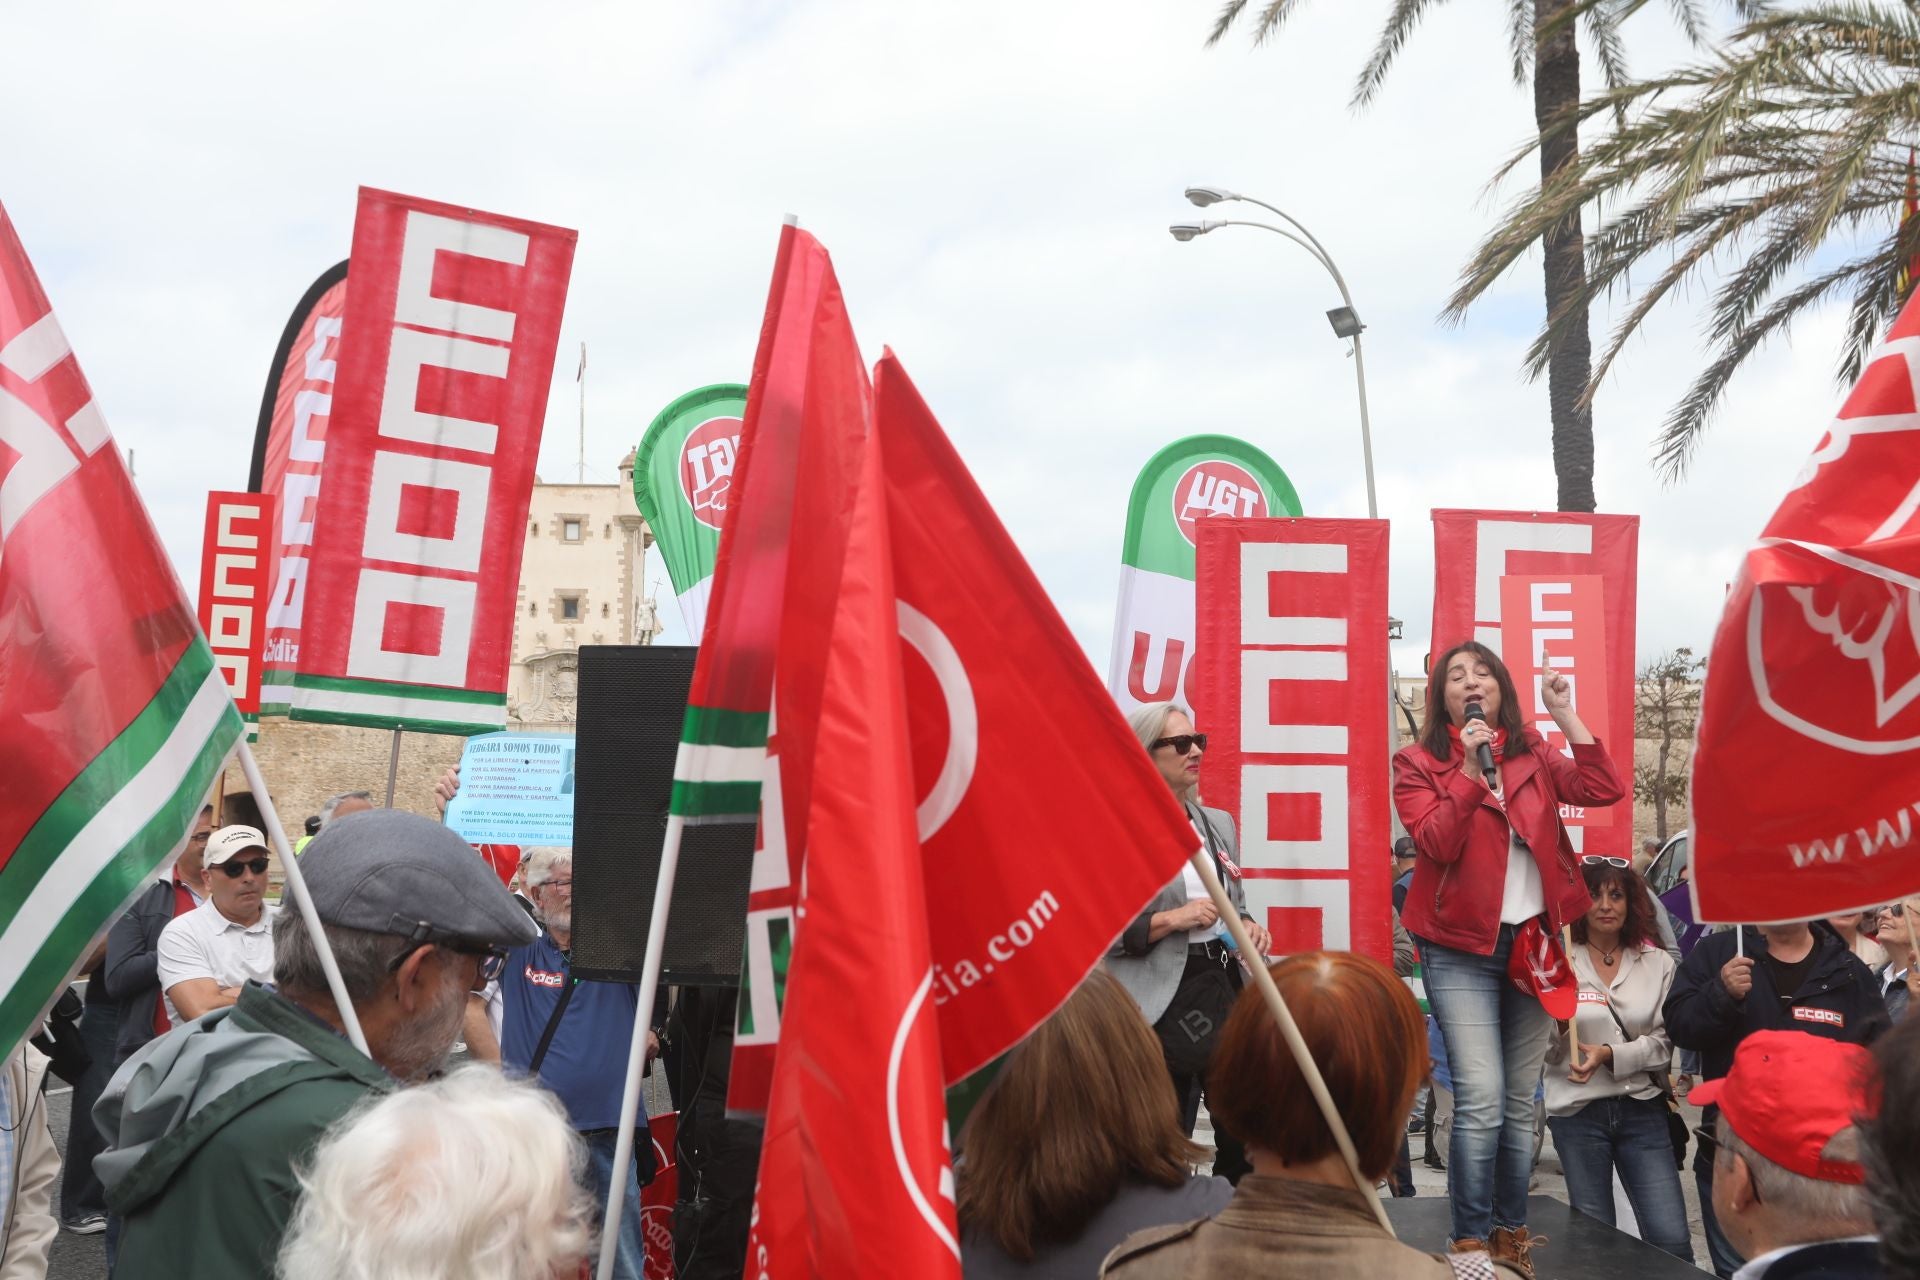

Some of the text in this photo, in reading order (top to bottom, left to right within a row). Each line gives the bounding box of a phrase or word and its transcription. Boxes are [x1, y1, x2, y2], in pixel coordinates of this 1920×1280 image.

[346, 209, 530, 687] CCOO
[1187, 471, 1258, 518] UGT
[213, 504, 260, 699] CCOO
[469, 743, 561, 754] VERGARA SOMOS TODOS
[1240, 542, 1350, 962] CCOO
[1794, 1008, 1834, 1021] CCOO
